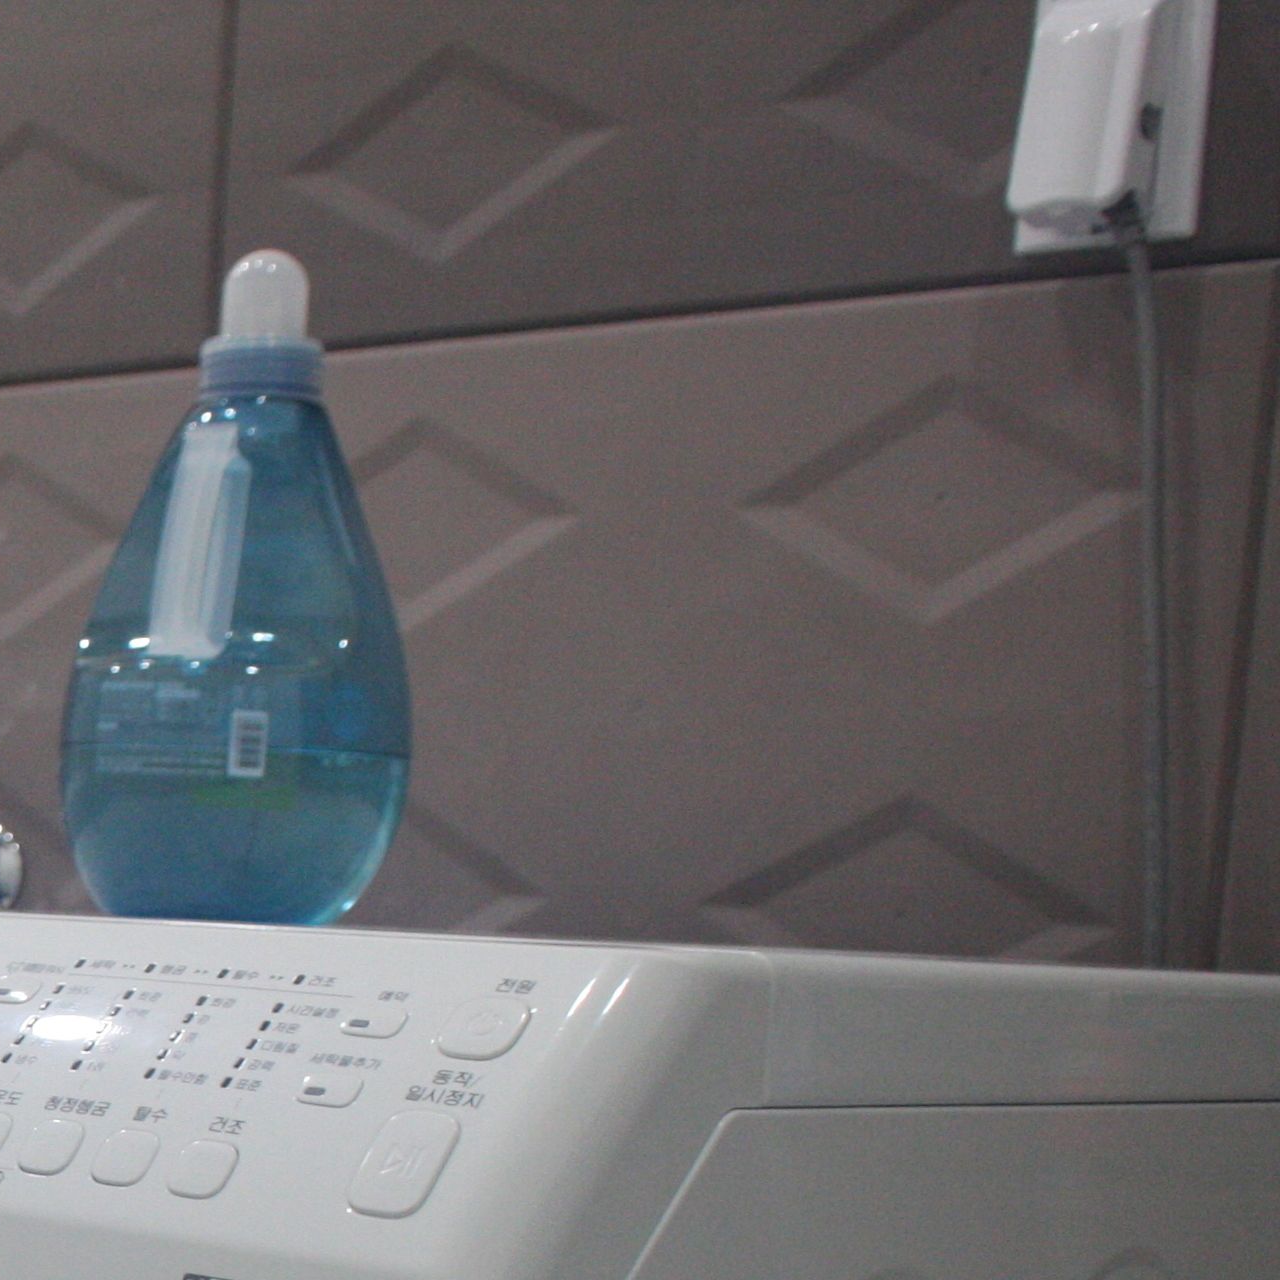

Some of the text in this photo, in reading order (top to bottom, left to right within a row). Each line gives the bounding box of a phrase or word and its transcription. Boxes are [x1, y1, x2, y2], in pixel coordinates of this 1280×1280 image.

[495, 977, 537, 995] 전원
[405, 1085, 485, 1110] 일시정지
[208, 1115, 247, 1135] 건조
